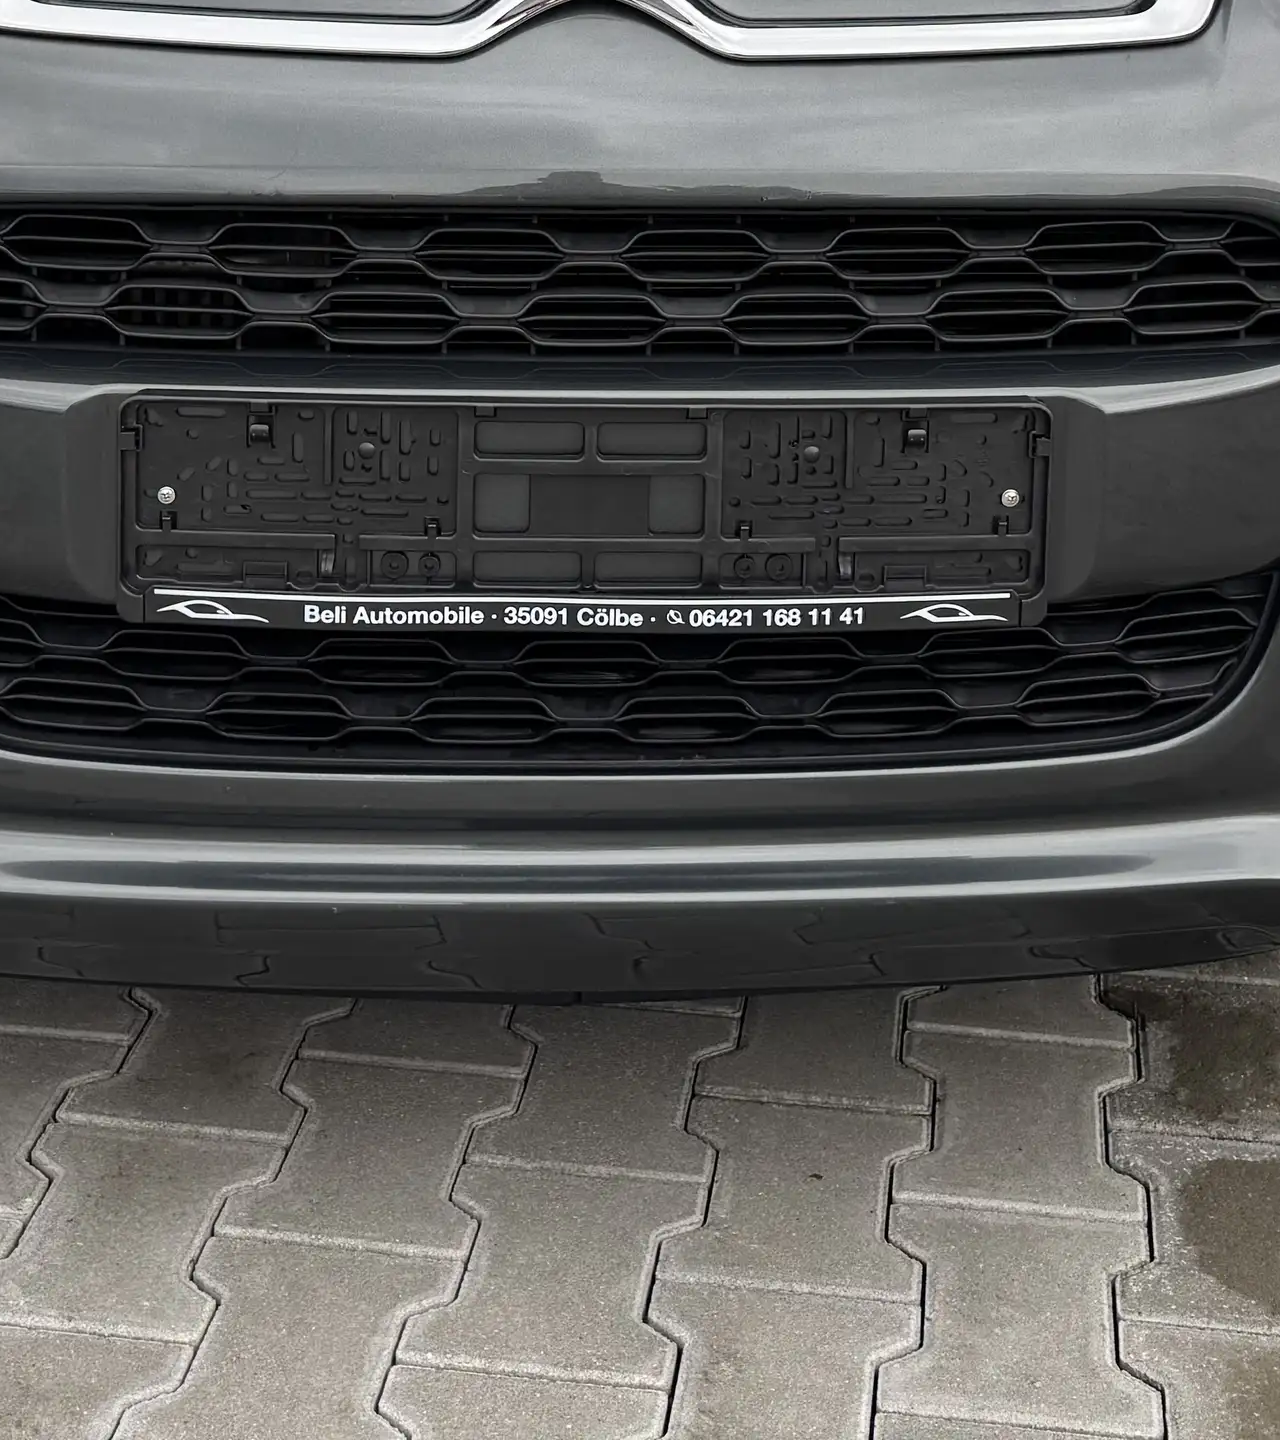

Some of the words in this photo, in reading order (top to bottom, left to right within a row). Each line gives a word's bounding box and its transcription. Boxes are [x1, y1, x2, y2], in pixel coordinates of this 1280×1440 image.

[304, 604, 347, 624] Beli
[352, 605, 485, 625] Automobile
[503, 606, 568, 626] 35091
[576, 607, 644, 627] Cölbe
[688, 608, 753, 628] 06421
[762, 607, 802, 627] 168
[807, 607, 831, 626] 11
[839, 606, 864, 625] 41
